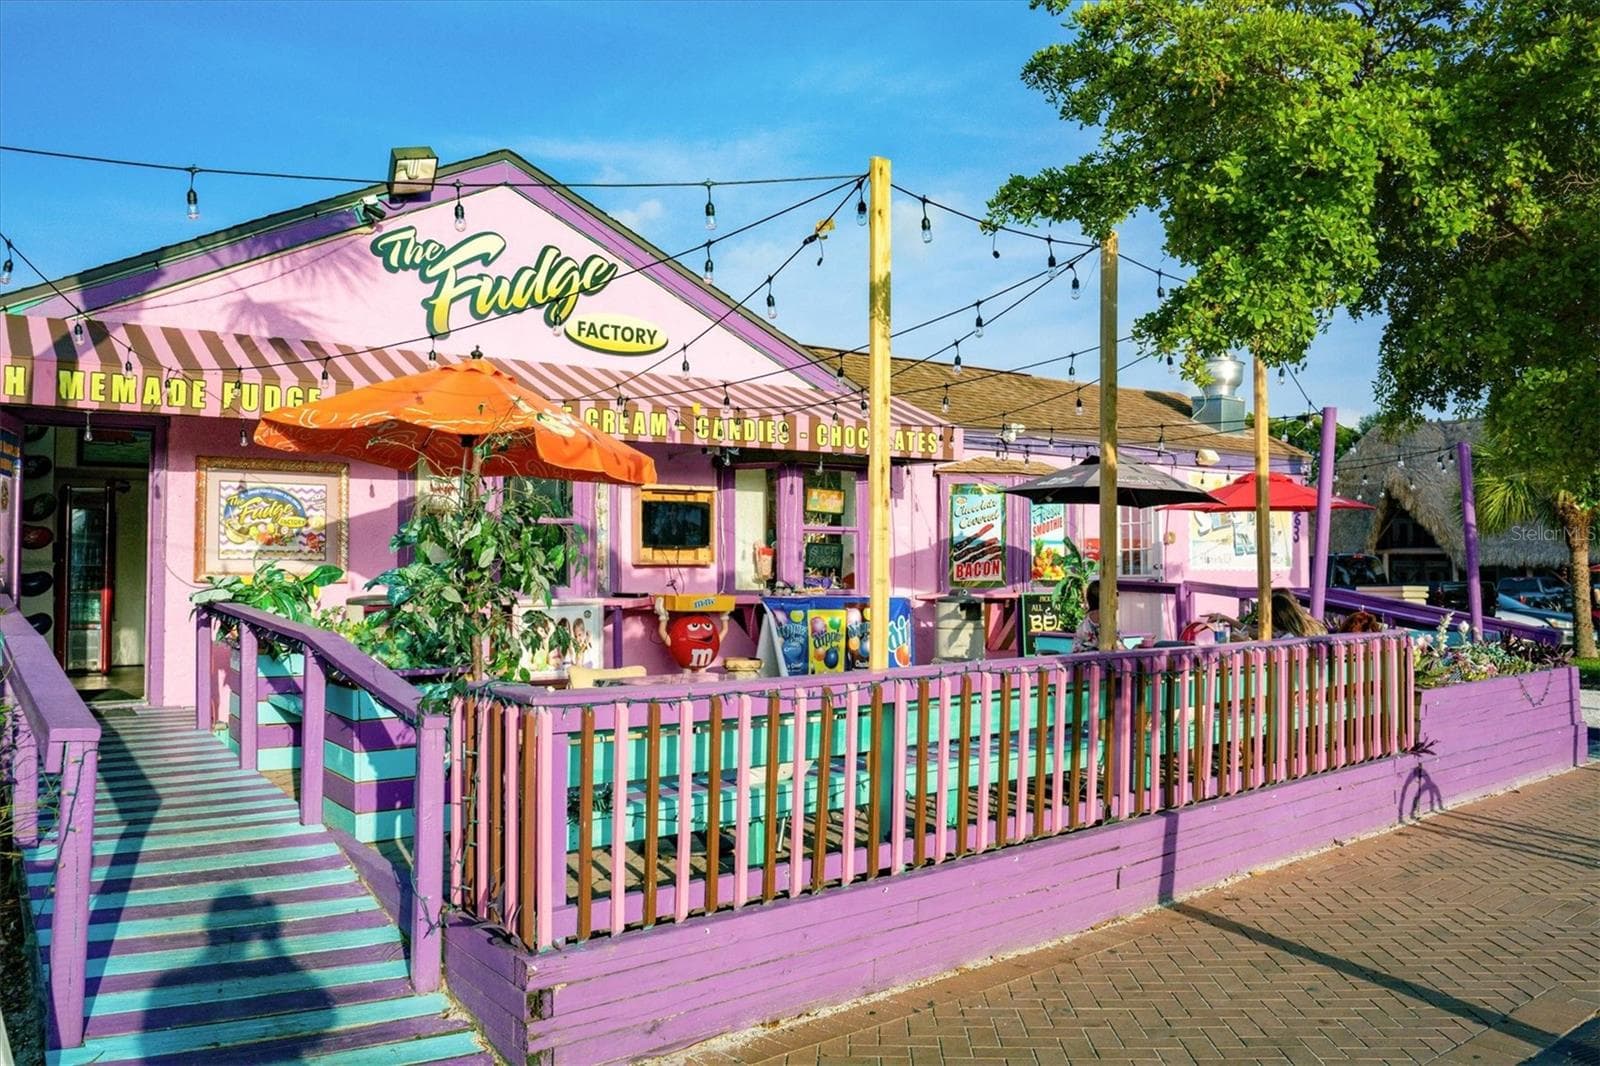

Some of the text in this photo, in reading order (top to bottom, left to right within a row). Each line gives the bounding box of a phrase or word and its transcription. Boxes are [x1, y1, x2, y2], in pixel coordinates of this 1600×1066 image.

[371, 226, 445, 273] The
[419, 232, 617, 340] Fudge
[576, 320, 658, 345] FACTORY
[585, 408, 668, 436] CREAM
[697, 415, 790, 443] CANDIES
[816, 424, 938, 453] CHOCATES
[238, 497, 293, 525] Fudge
[1032, 516, 1063, 538] SMOOTHIE
[956, 560, 1000, 579] BACON
